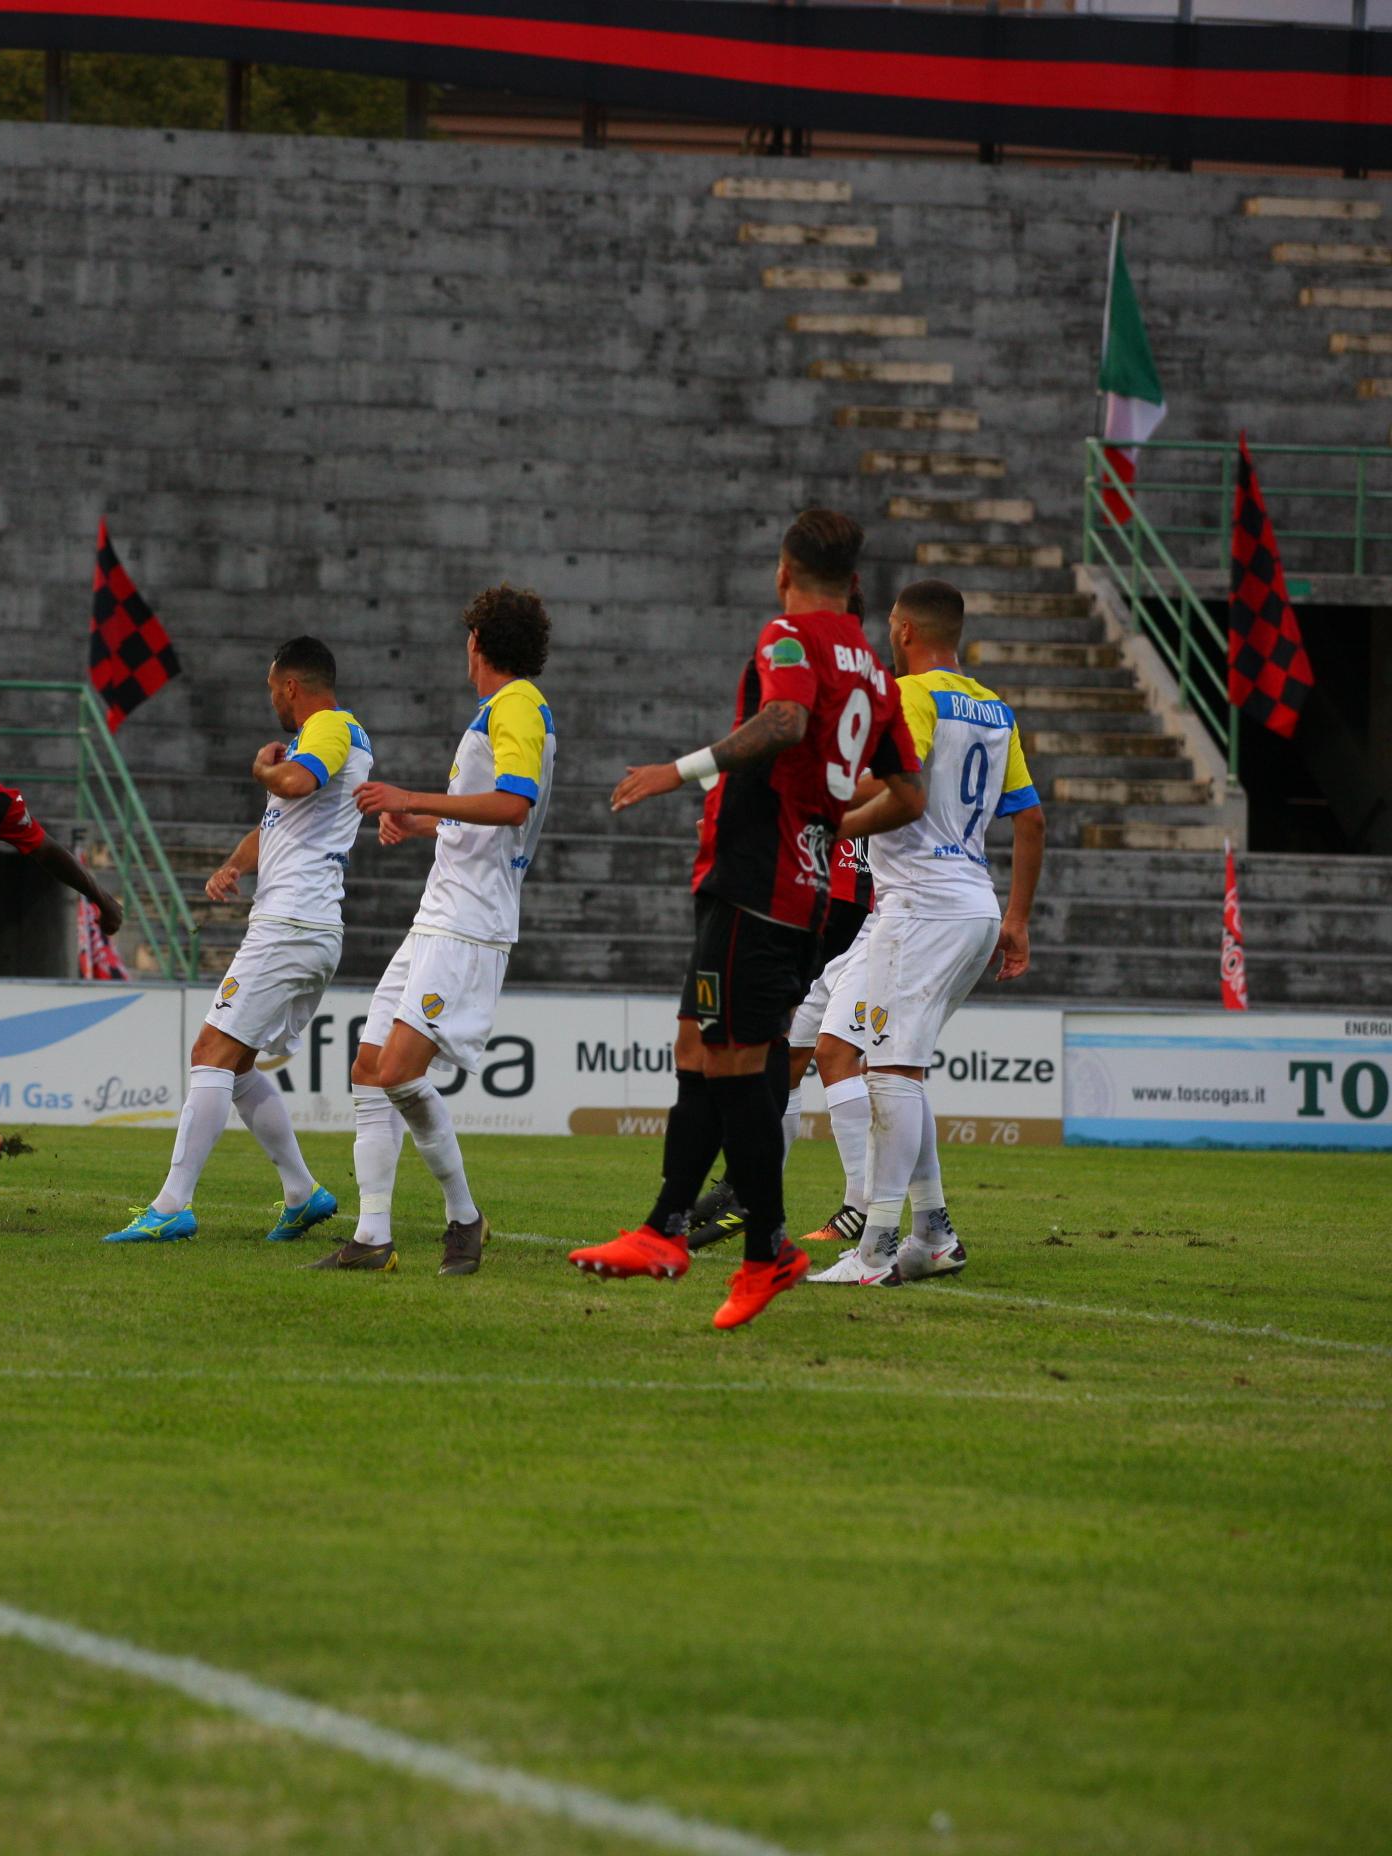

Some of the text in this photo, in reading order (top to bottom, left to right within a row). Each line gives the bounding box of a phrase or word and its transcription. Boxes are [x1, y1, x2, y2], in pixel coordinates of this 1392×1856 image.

[826, 688, 872, 801] 9
[960, 742, 989, 846] 9
[577, 1041, 1055, 1083] Mutui Polizze
[23, 1083, 73, 1110] Gas
[1132, 1085, 1266, 1106] www.toscogas.it
[947, 1121, 1020, 1145] 76 76
